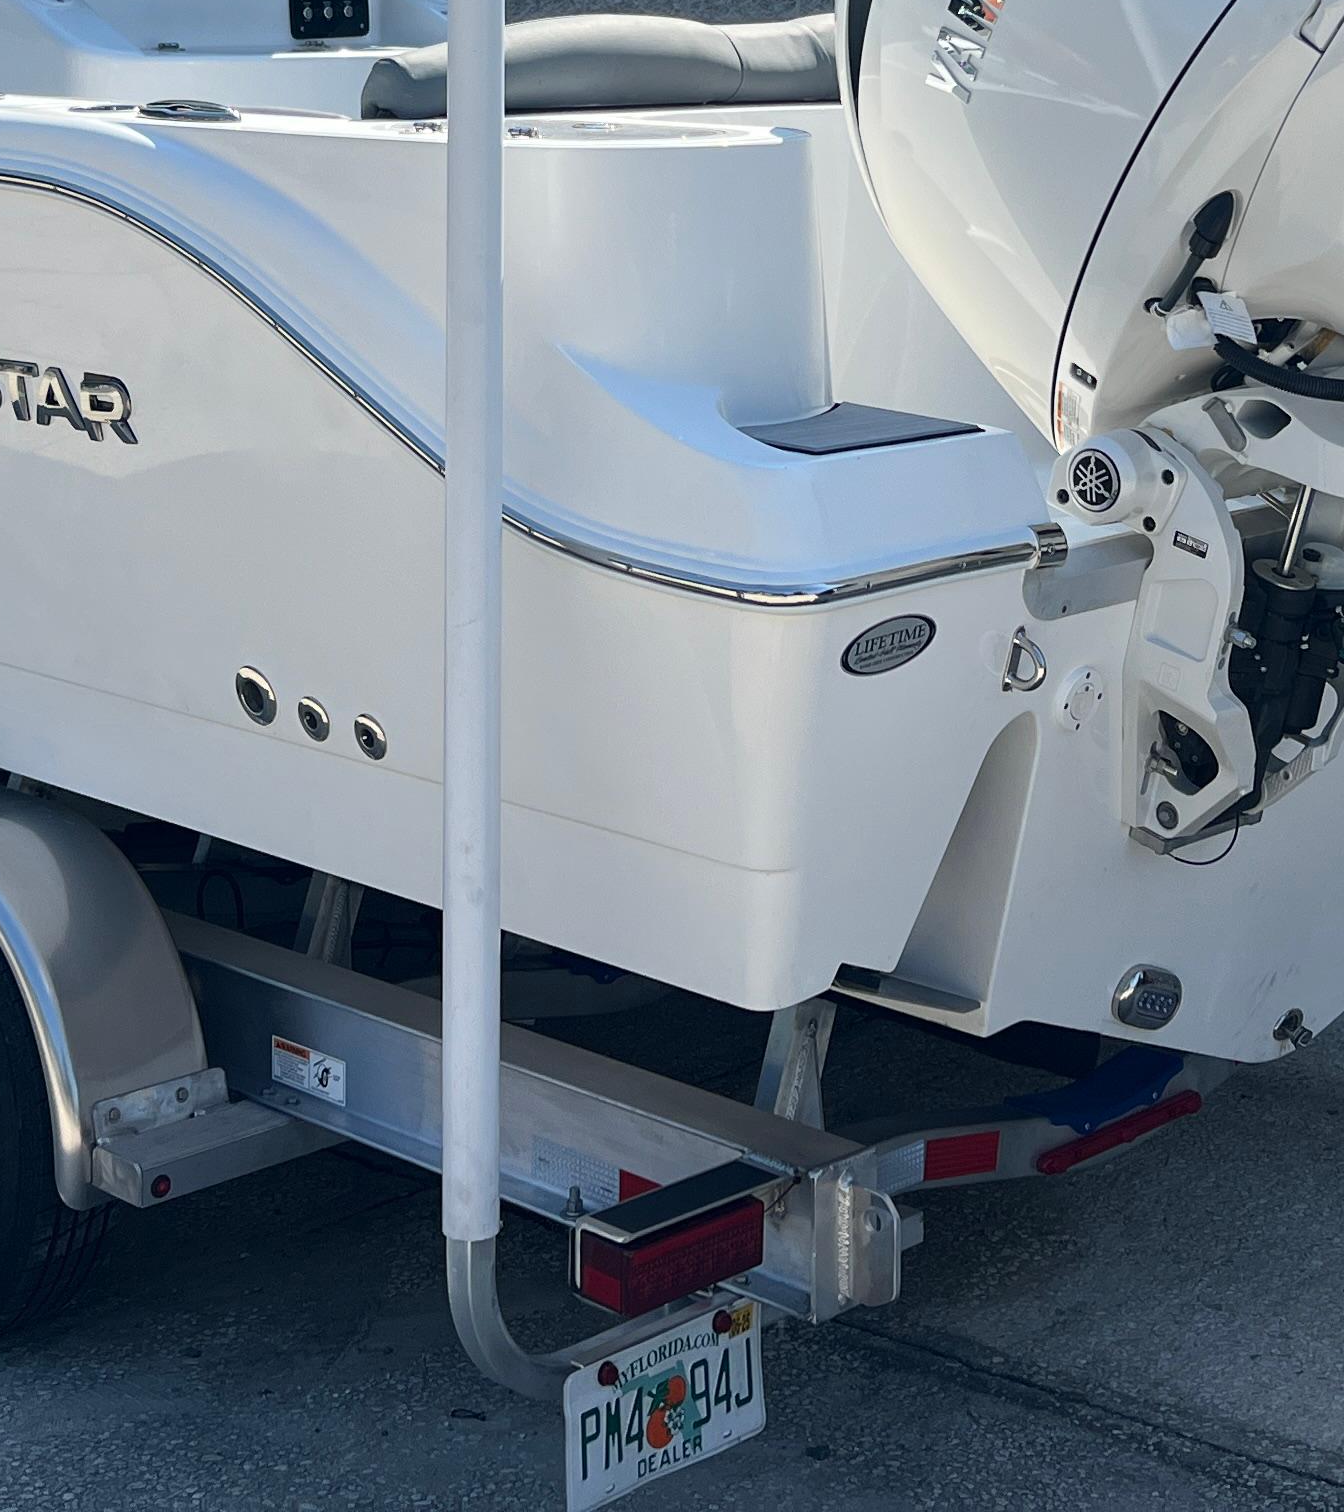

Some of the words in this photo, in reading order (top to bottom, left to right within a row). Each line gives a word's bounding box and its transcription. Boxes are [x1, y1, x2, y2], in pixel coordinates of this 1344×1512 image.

[854, 623, 927, 657] LIFETIME
[580, 1385, 645, 1482] PM4
[689, 1336, 755, 1430] 94J
[637, 1434, 704, 1479] DEALER
